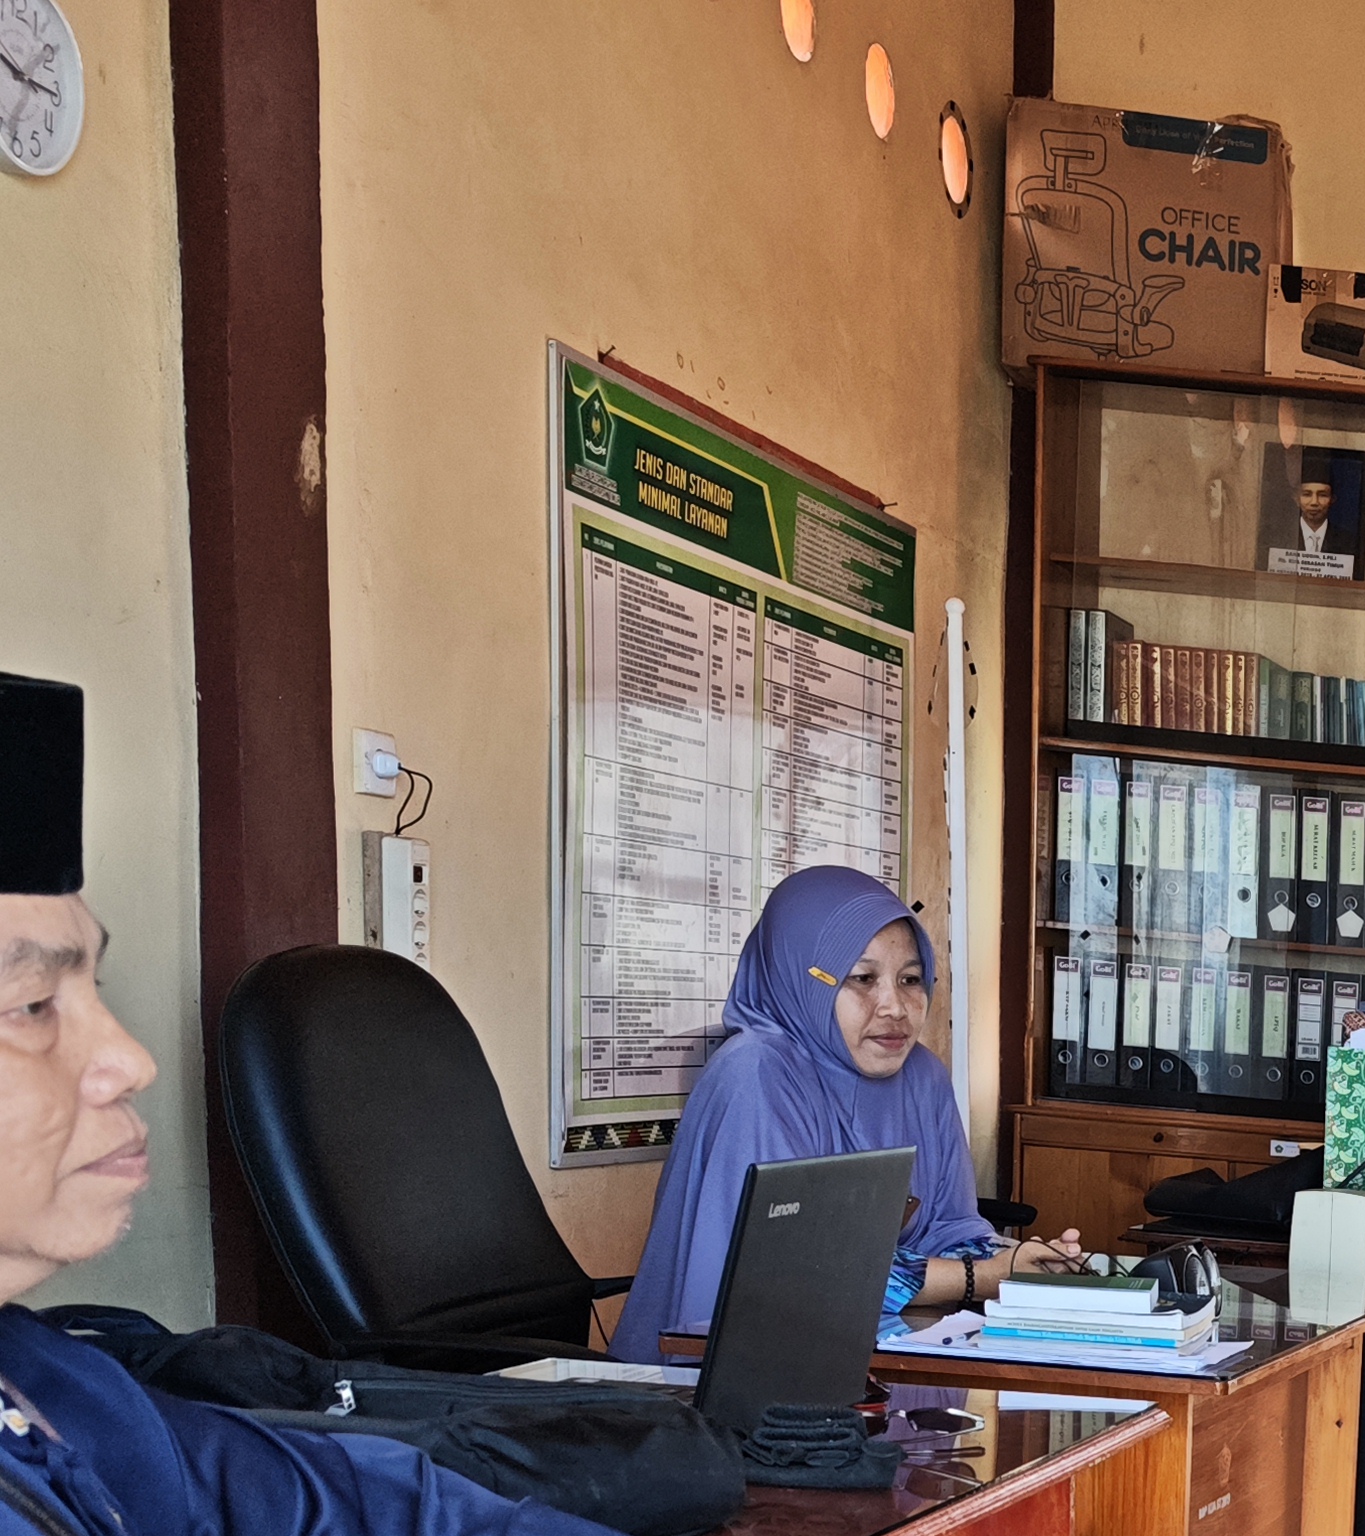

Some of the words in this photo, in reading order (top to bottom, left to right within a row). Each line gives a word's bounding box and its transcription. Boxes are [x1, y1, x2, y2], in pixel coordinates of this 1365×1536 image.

[1161, 206, 1241, 235] OFFICE
[1138, 227, 1262, 277] CHAIR
[634, 448, 664, 480] JENIS
[665, 461, 687, 491] DAN
[689, 473, 734, 512] STANDAR
[638, 480, 683, 520] MINIMAL
[684, 500, 728, 539] LAYANAN
[768, 1201, 801, 1219] Lenovo
